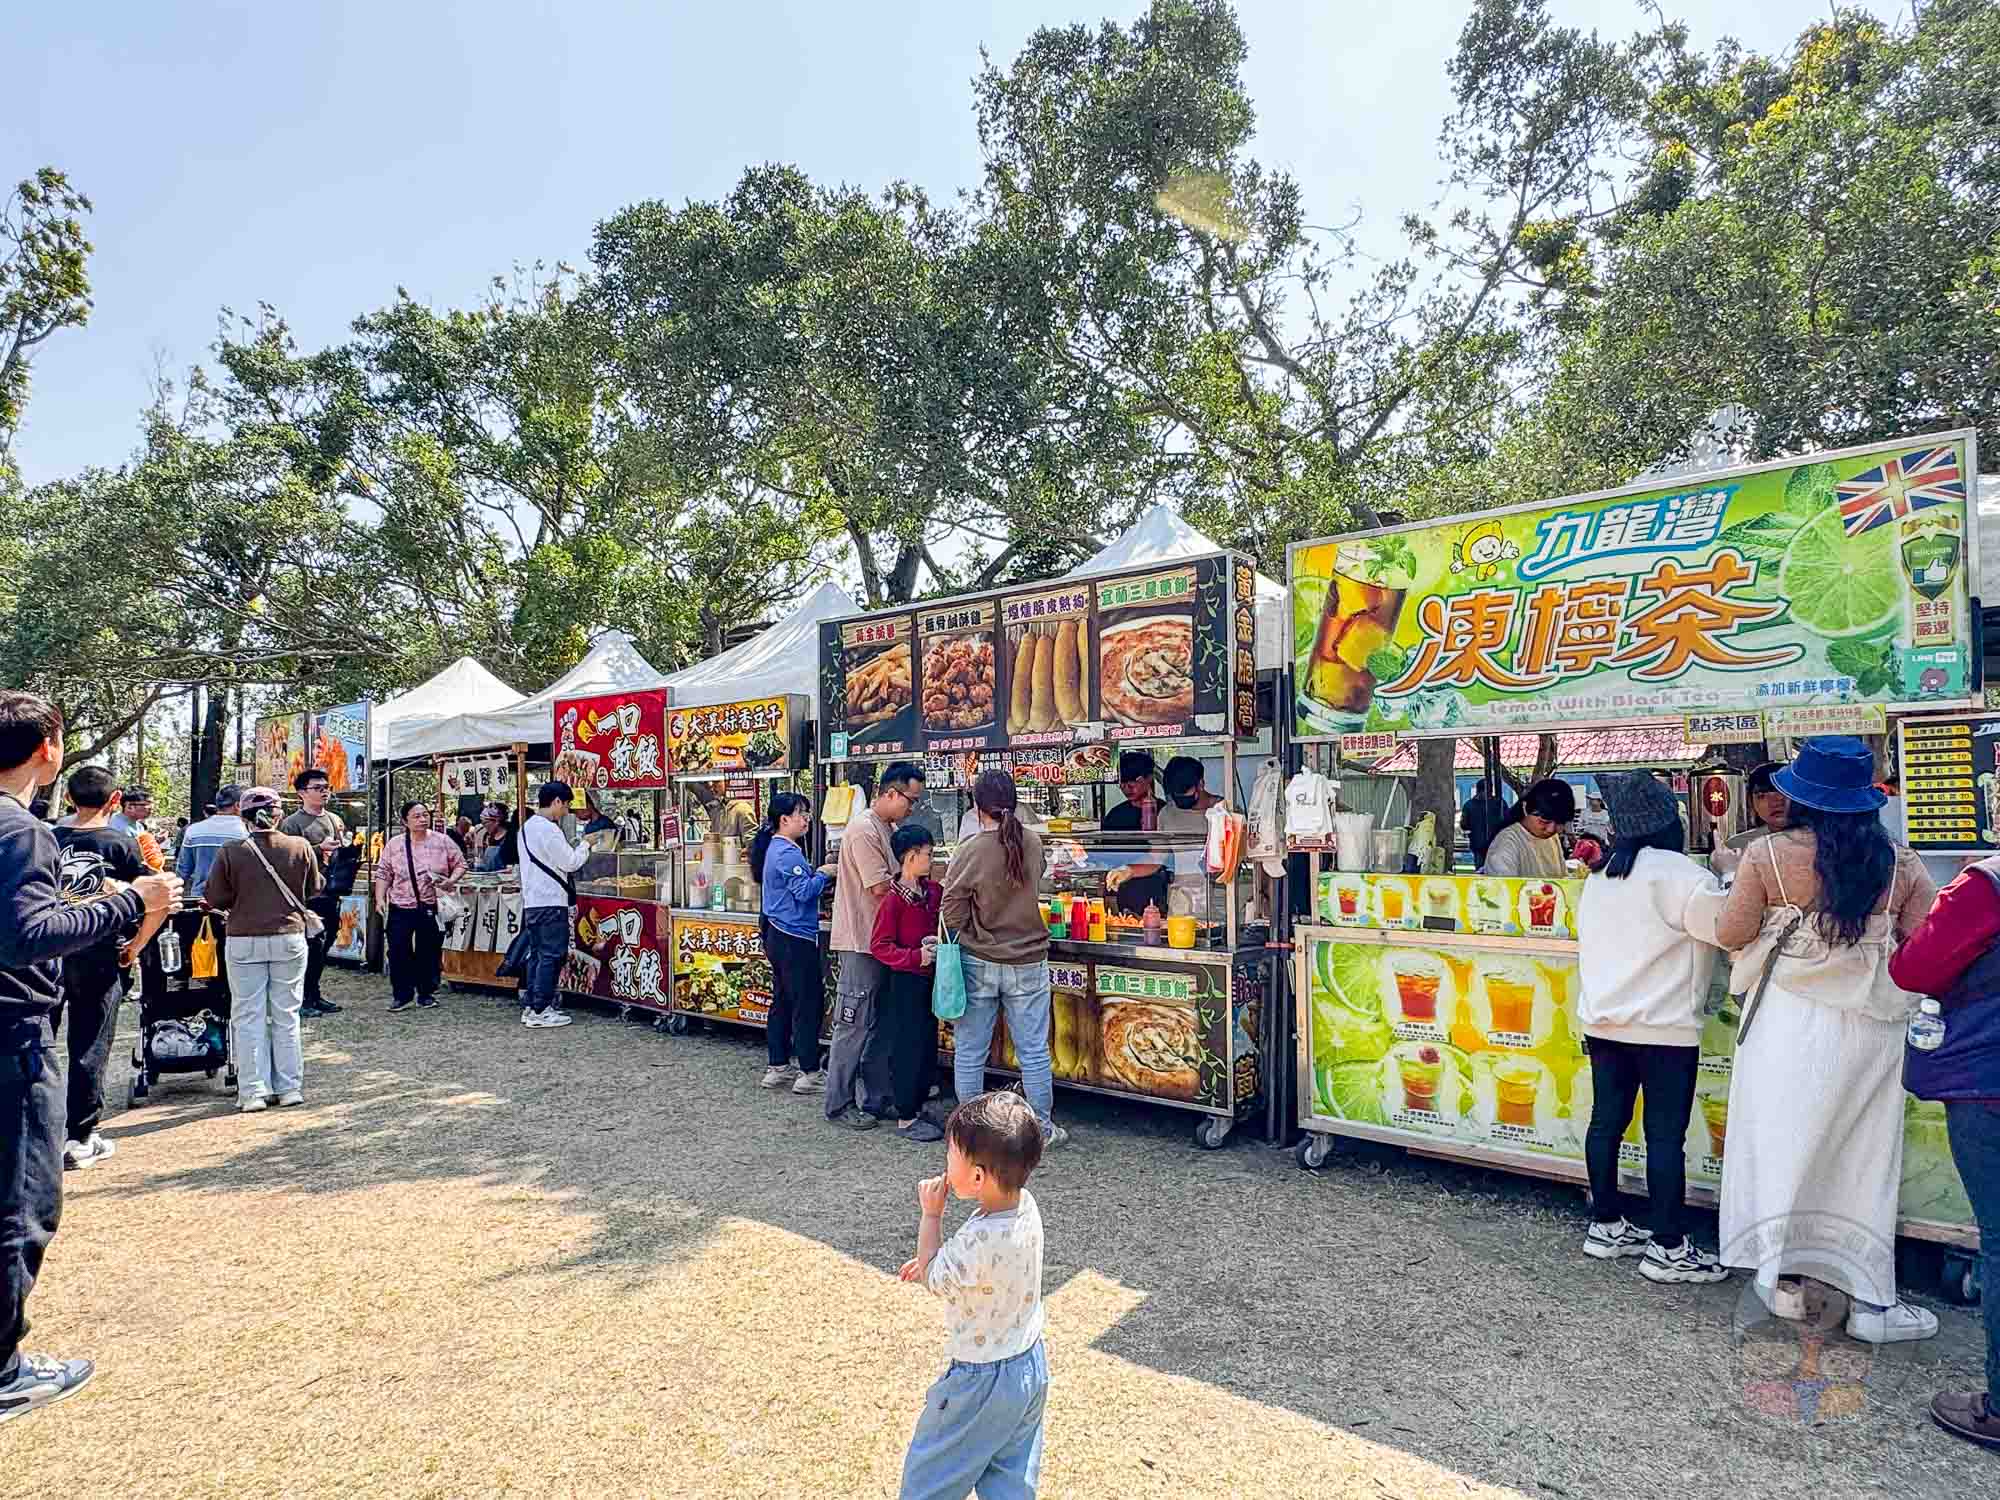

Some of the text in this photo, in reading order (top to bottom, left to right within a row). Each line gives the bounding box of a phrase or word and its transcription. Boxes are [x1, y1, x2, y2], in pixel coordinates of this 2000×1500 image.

[1518, 497, 1728, 578] 九龍灣
[1915, 600, 1950, 618] 堅持
[596, 703, 642, 736] 一口
[688, 704, 782, 736] 大溪蒜香豆干
[1689, 714, 1759, 732] 點茶區
[1034, 765, 1061, 781] 100
[599, 909, 643, 946] 一口
[1098, 972, 1189, 998] 宜蘭三星蔥餅
